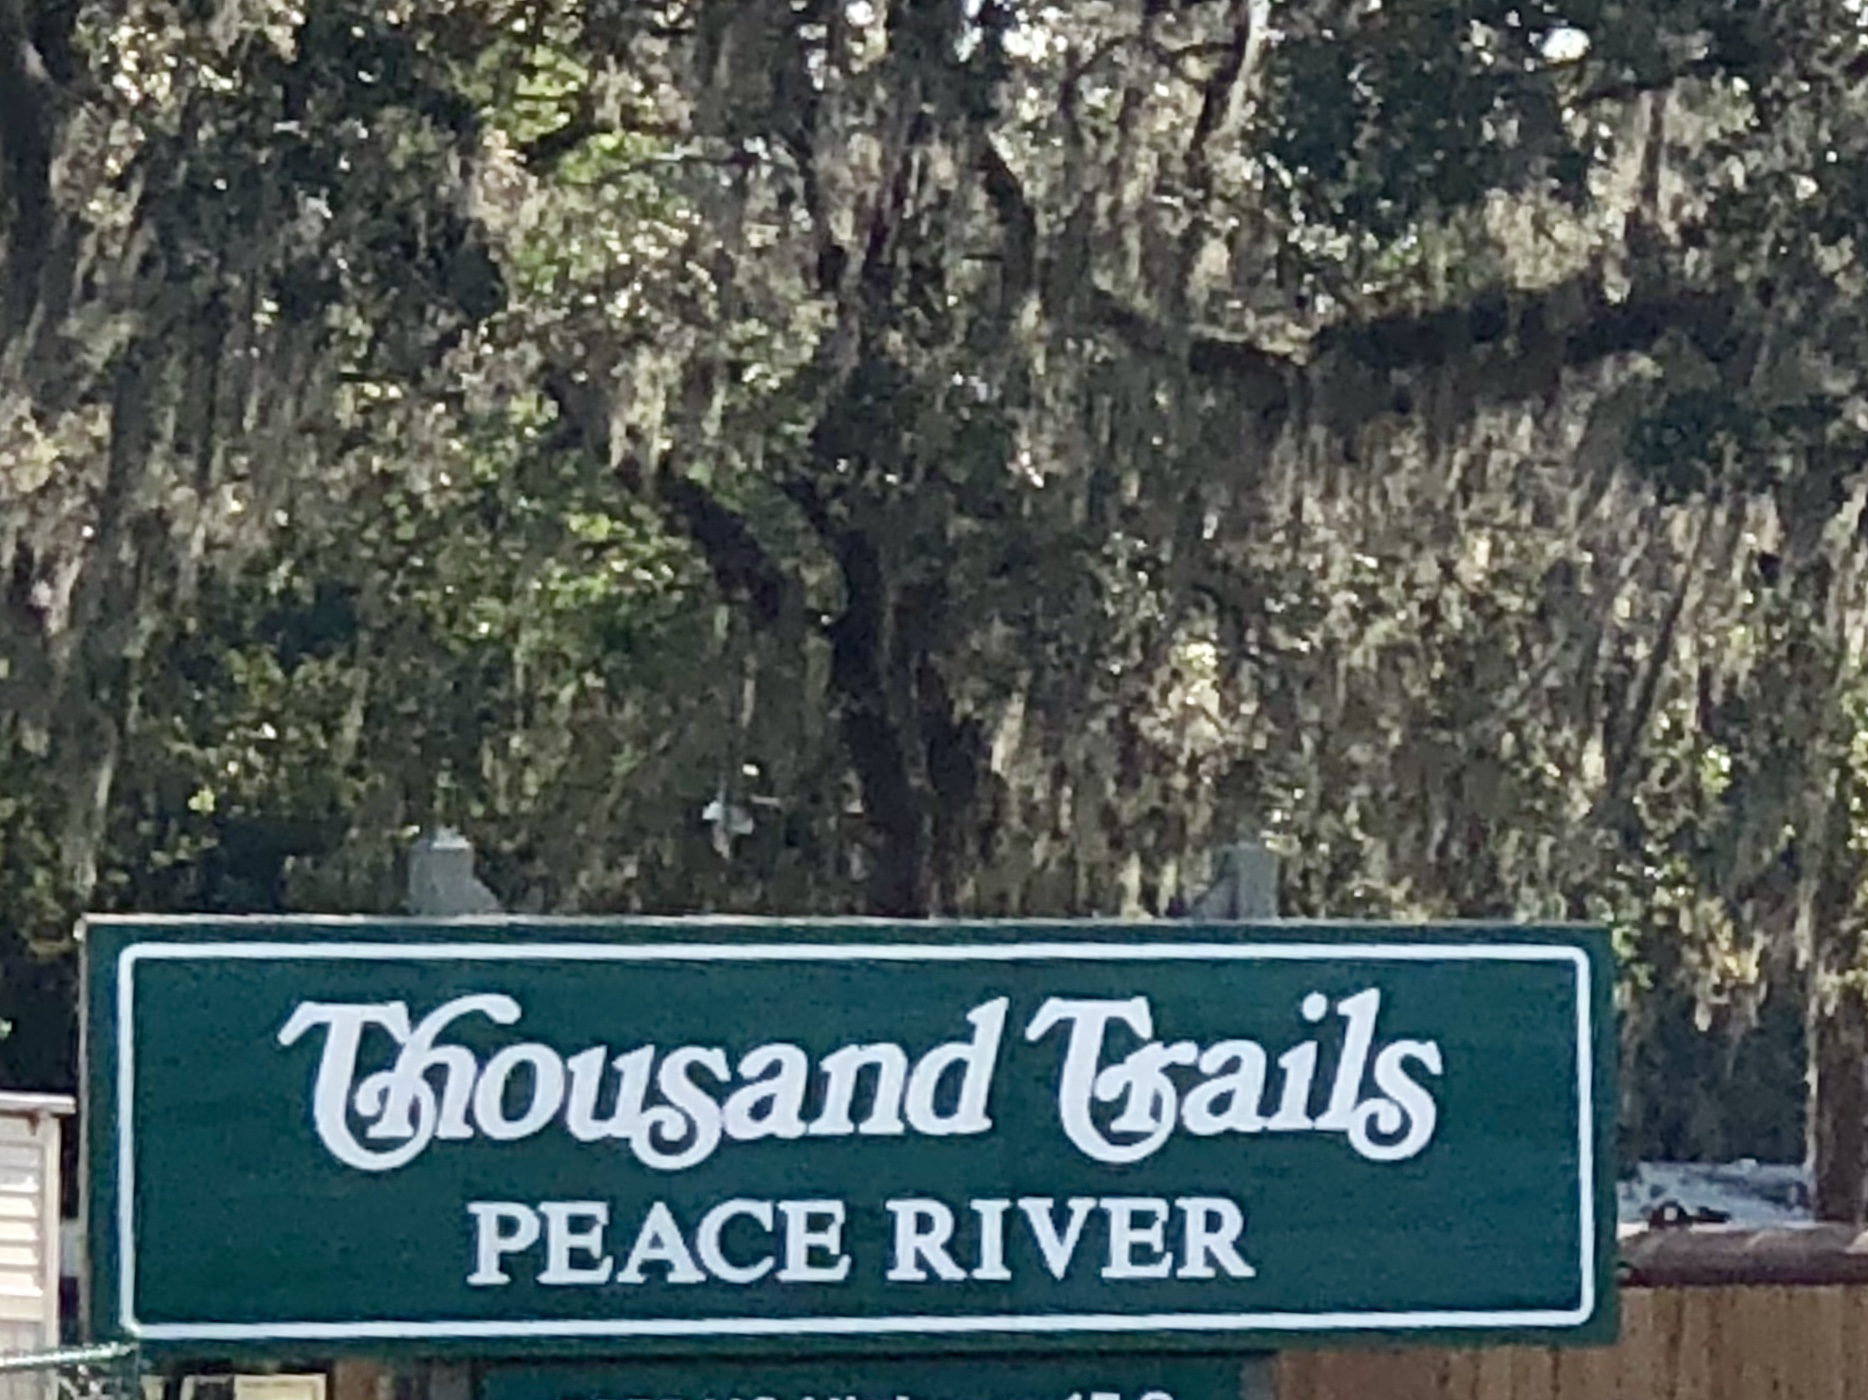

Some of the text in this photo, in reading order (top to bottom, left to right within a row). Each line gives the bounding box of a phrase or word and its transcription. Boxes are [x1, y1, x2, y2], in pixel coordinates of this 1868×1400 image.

[278, 988, 1442, 1171] Thousand Trails
[467, 1197, 1255, 1284] PEACE RIVER
